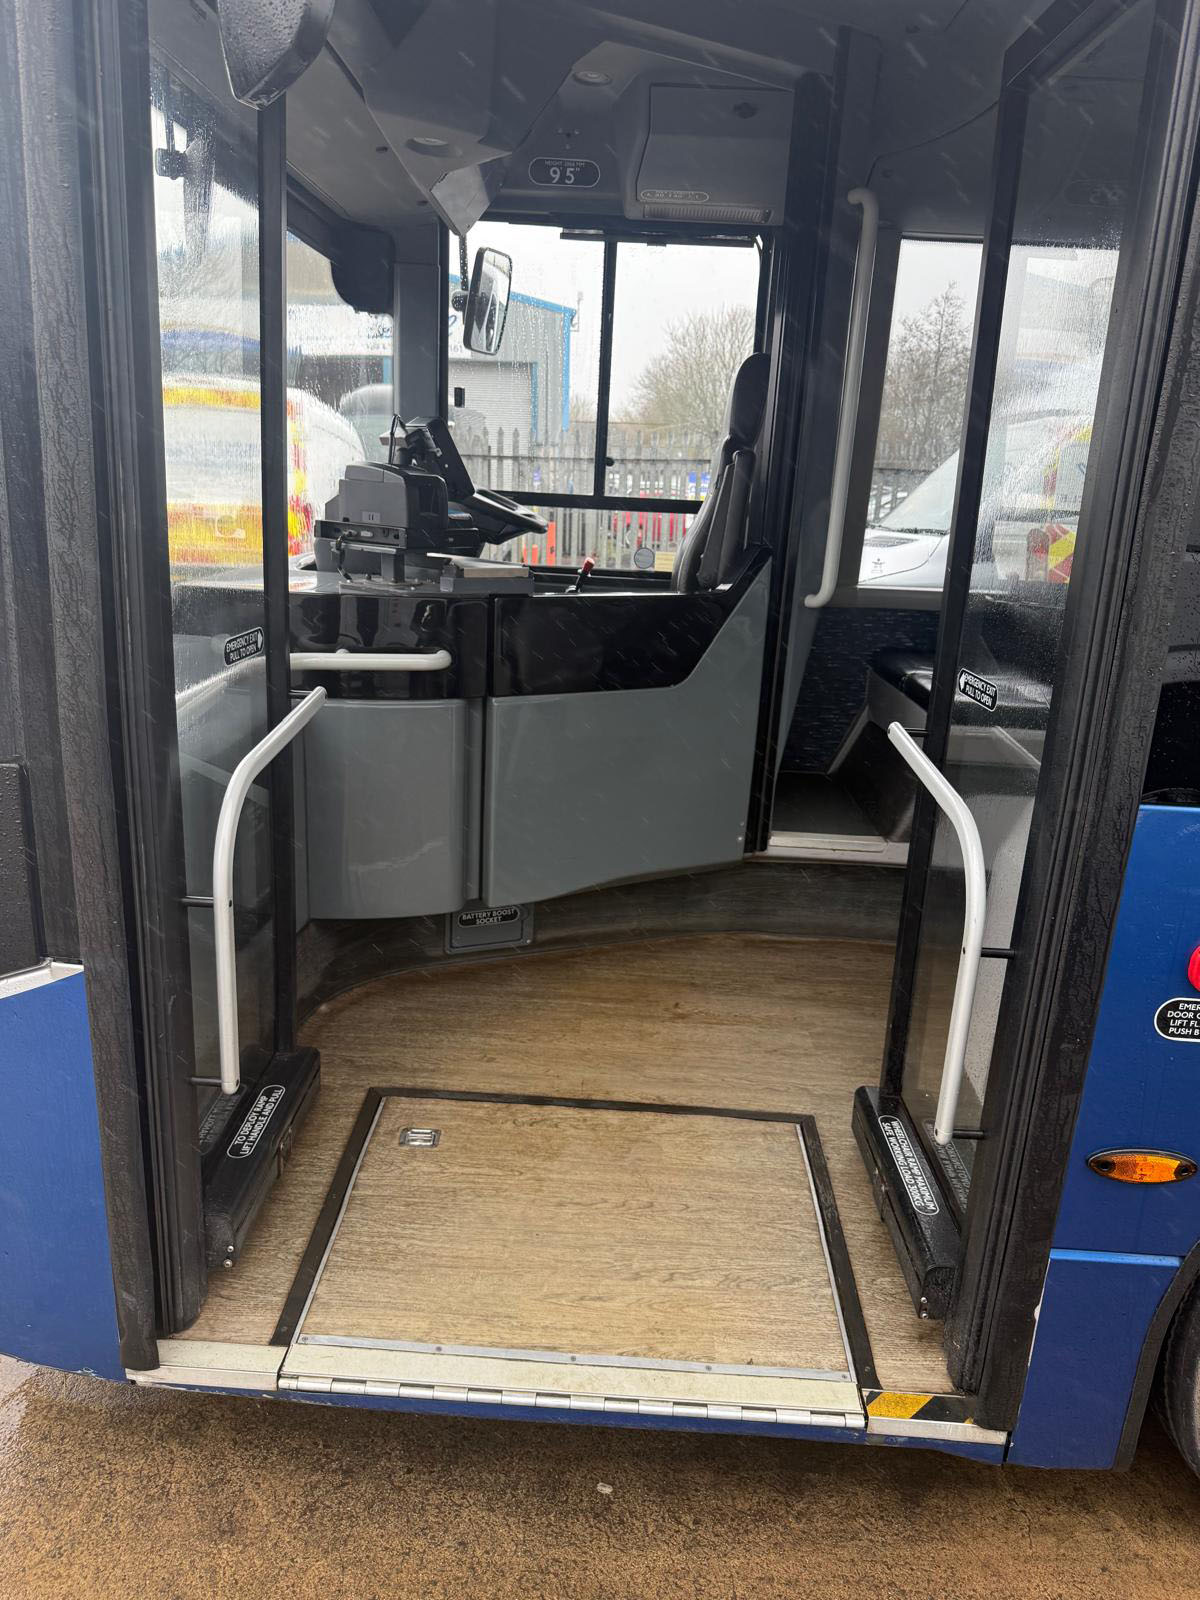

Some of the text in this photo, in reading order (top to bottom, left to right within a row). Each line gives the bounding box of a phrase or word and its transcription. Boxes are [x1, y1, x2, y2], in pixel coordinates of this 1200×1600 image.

[226, 632, 257, 652] EMERGENCY EXIT
[230, 652, 240, 661] PULL
[246, 643, 257, 655] OPEN
[964, 673, 996, 696] EMERGENCY EXIT
[965, 685, 975, 697] PULL
[981, 693, 992, 706] OPEN
[462, 908, 514, 920] BATTERY BOOST
[476, 917, 502, 925] SOCKET
[1167, 1010, 1194, 1018] DOOR
[1170, 1019, 1188, 1027] LIFT
[1168, 1027, 1192, 1035] PUSH
[234, 1095, 268, 1145] TO DEPLOY RAMP
[240, 1089, 283, 1154] LIFT HANDLE AND PULL
[882, 1122, 895, 1137] SAFE
[888, 1136, 908, 1167] WORKING
[891, 1120, 937, 1210] WHEELCHAIR RAMP MAXIMUM
[901, 1165, 915, 1185] LOAD
